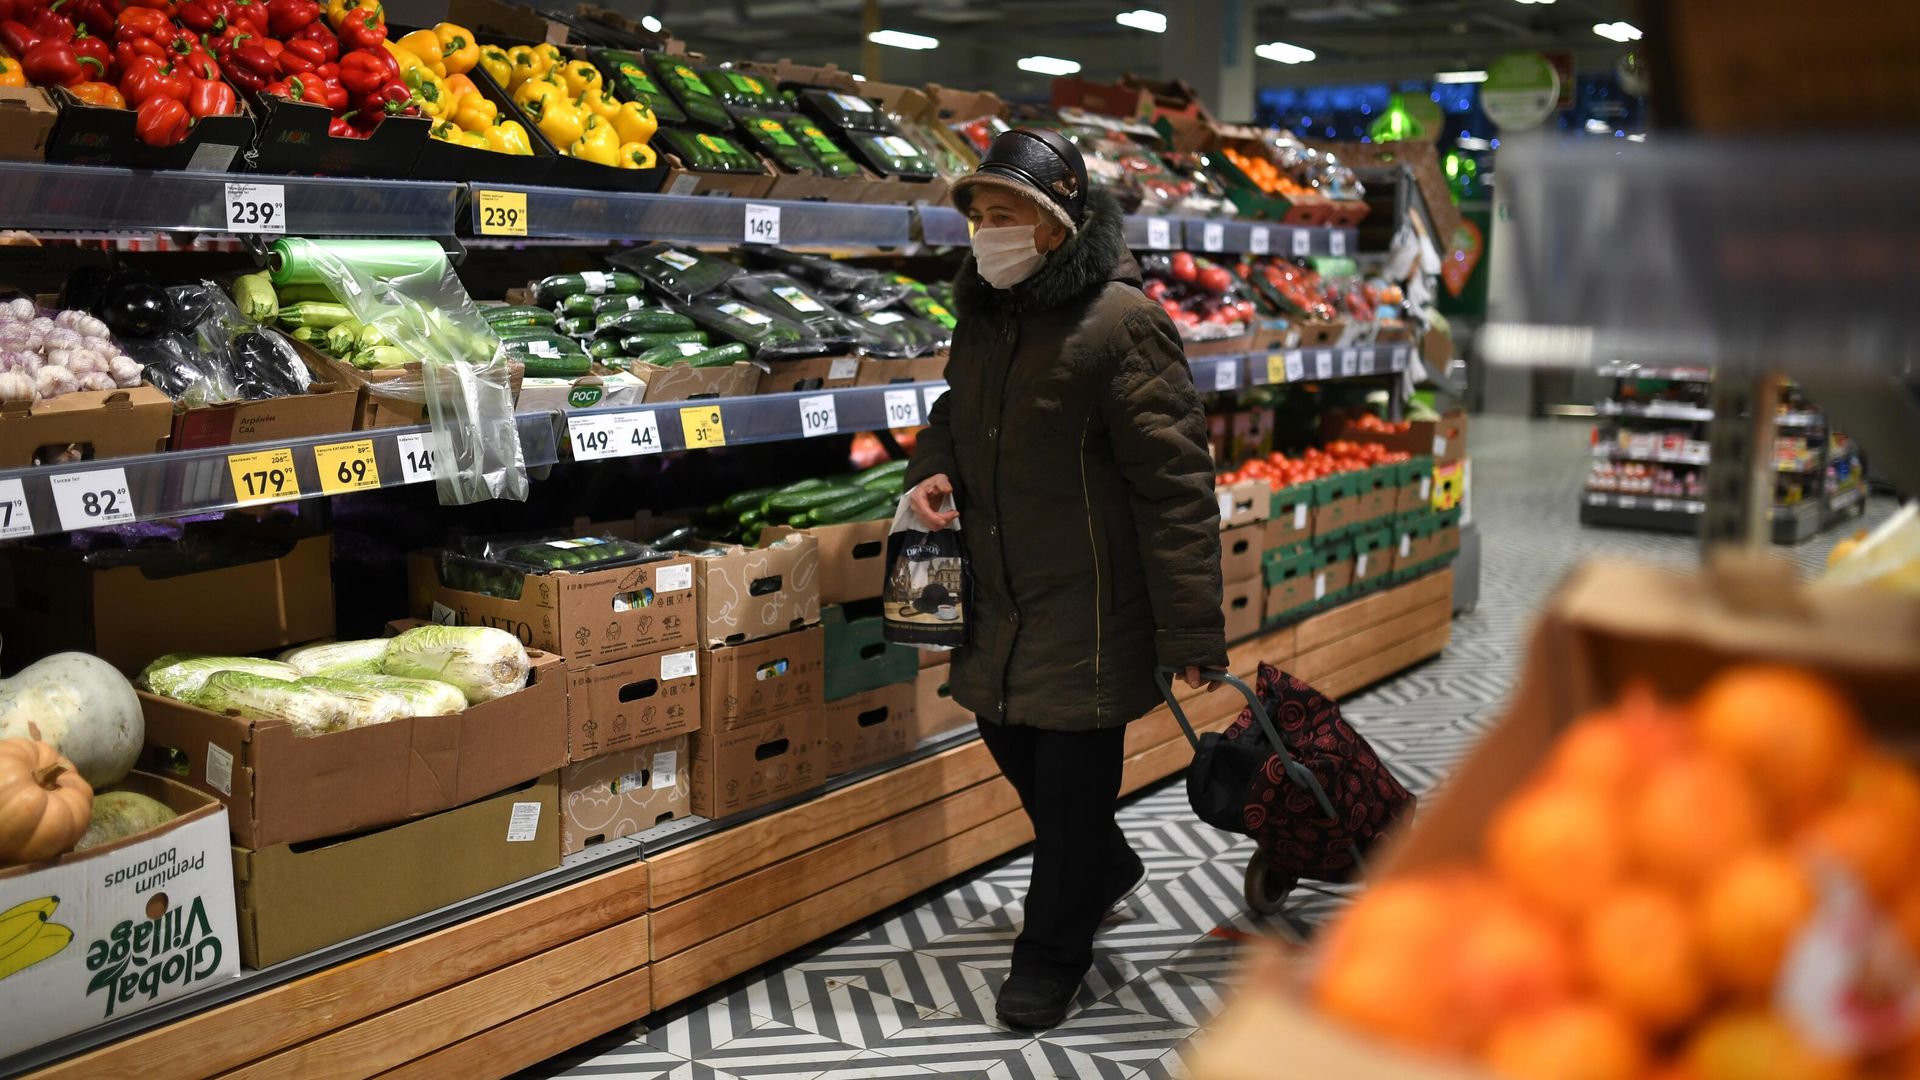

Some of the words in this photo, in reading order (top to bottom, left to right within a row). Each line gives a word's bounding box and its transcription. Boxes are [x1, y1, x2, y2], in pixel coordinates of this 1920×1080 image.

[232, 201, 275, 224] 239
[485, 207, 518, 227] 239
[750, 218, 773, 236] 149
[572, 390, 599, 401] РОСТ
[805, 409, 829, 429] 109
[890, 404, 912, 421] 109
[577, 430, 608, 452] 149
[631, 427, 652, 446] 44
[695, 428, 708, 441] 31
[242, 469, 285, 496] 179
[337, 459, 366, 484] 69
[82, 490, 120, 517] 82
[104, 847, 177, 887] bananas
[135, 851, 205, 894] Premium
[86, 895, 214, 971] Village
[85, 936, 222, 1019] Global
